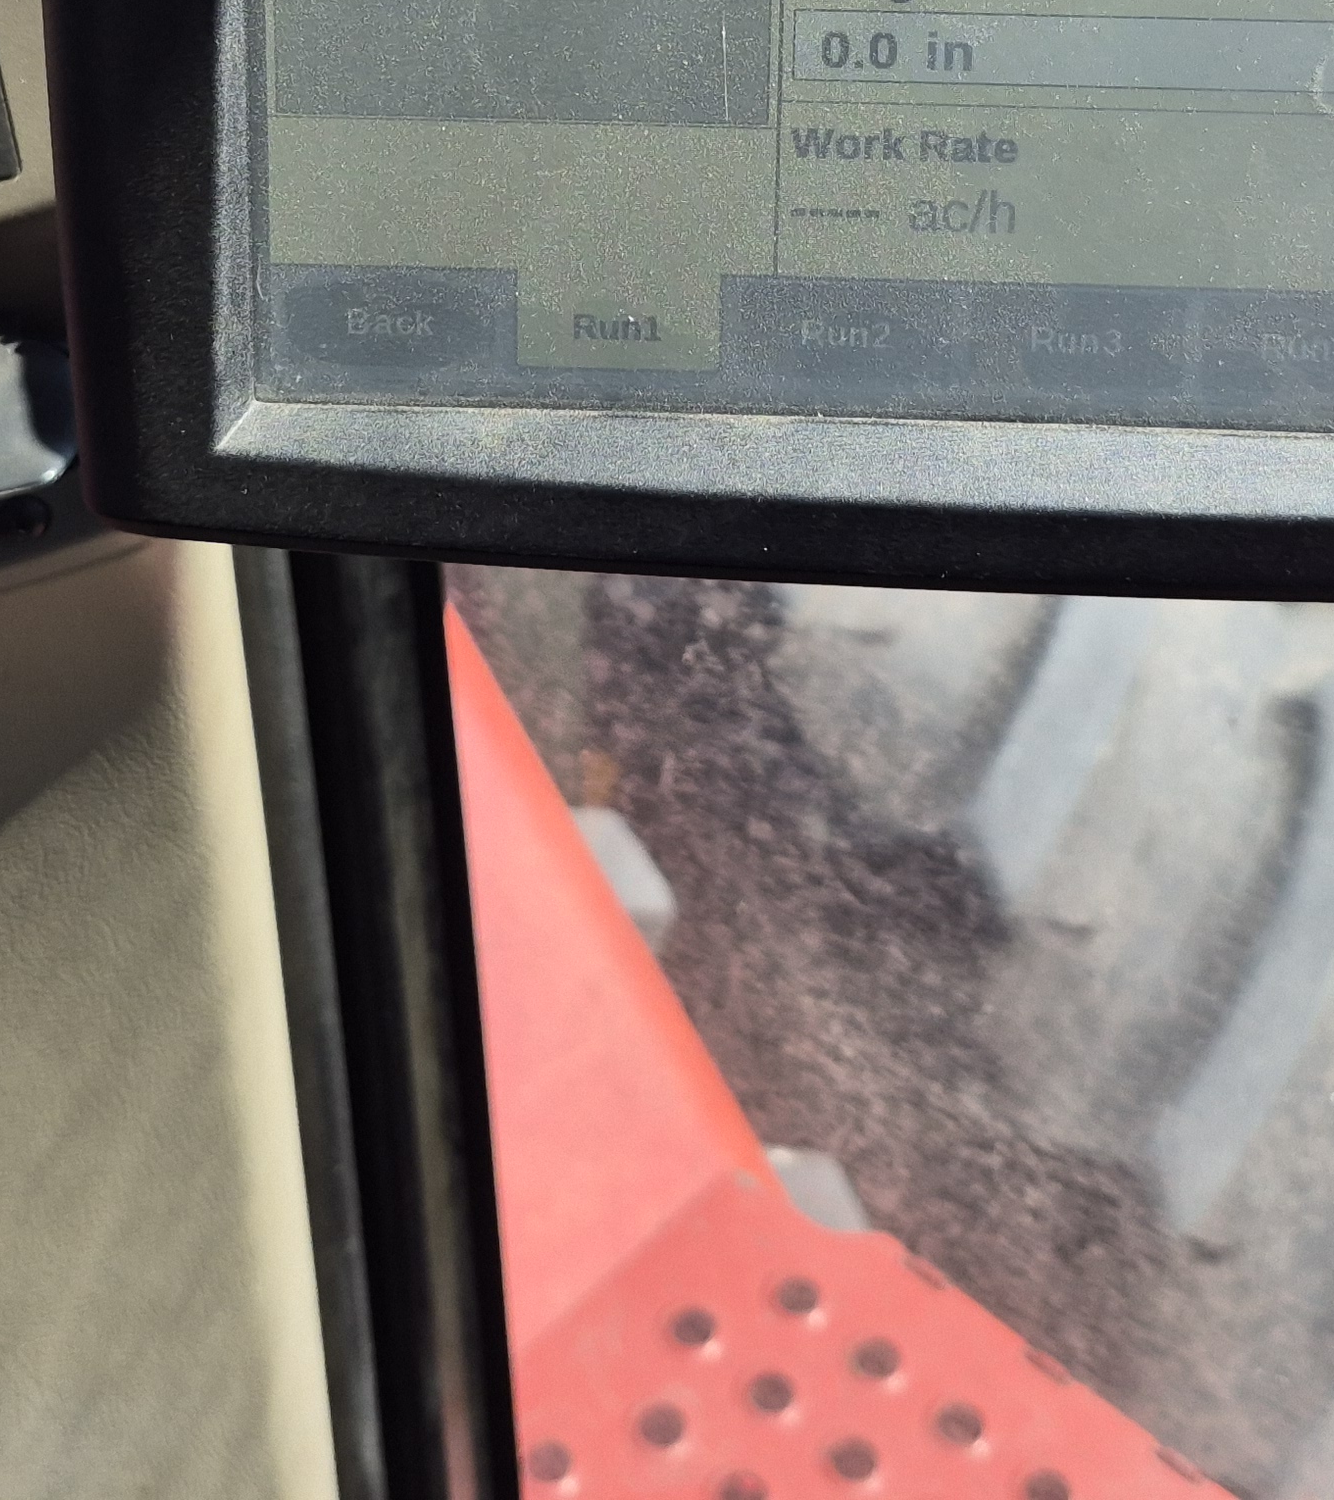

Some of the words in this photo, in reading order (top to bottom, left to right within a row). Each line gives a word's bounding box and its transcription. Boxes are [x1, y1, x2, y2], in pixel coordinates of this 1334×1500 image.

[821, 32, 898, 69] 0.0
[927, 31, 974, 71] in
[791, 128, 904, 161] Work
[920, 131, 1019, 164] Rate
[908, 190, 1016, 234] ac/h
[346, 308, 434, 337] Back
[573, 313, 661, 342] Run1
[801, 322, 892, 350] Run2
[1030, 327, 1123, 355] Run3
